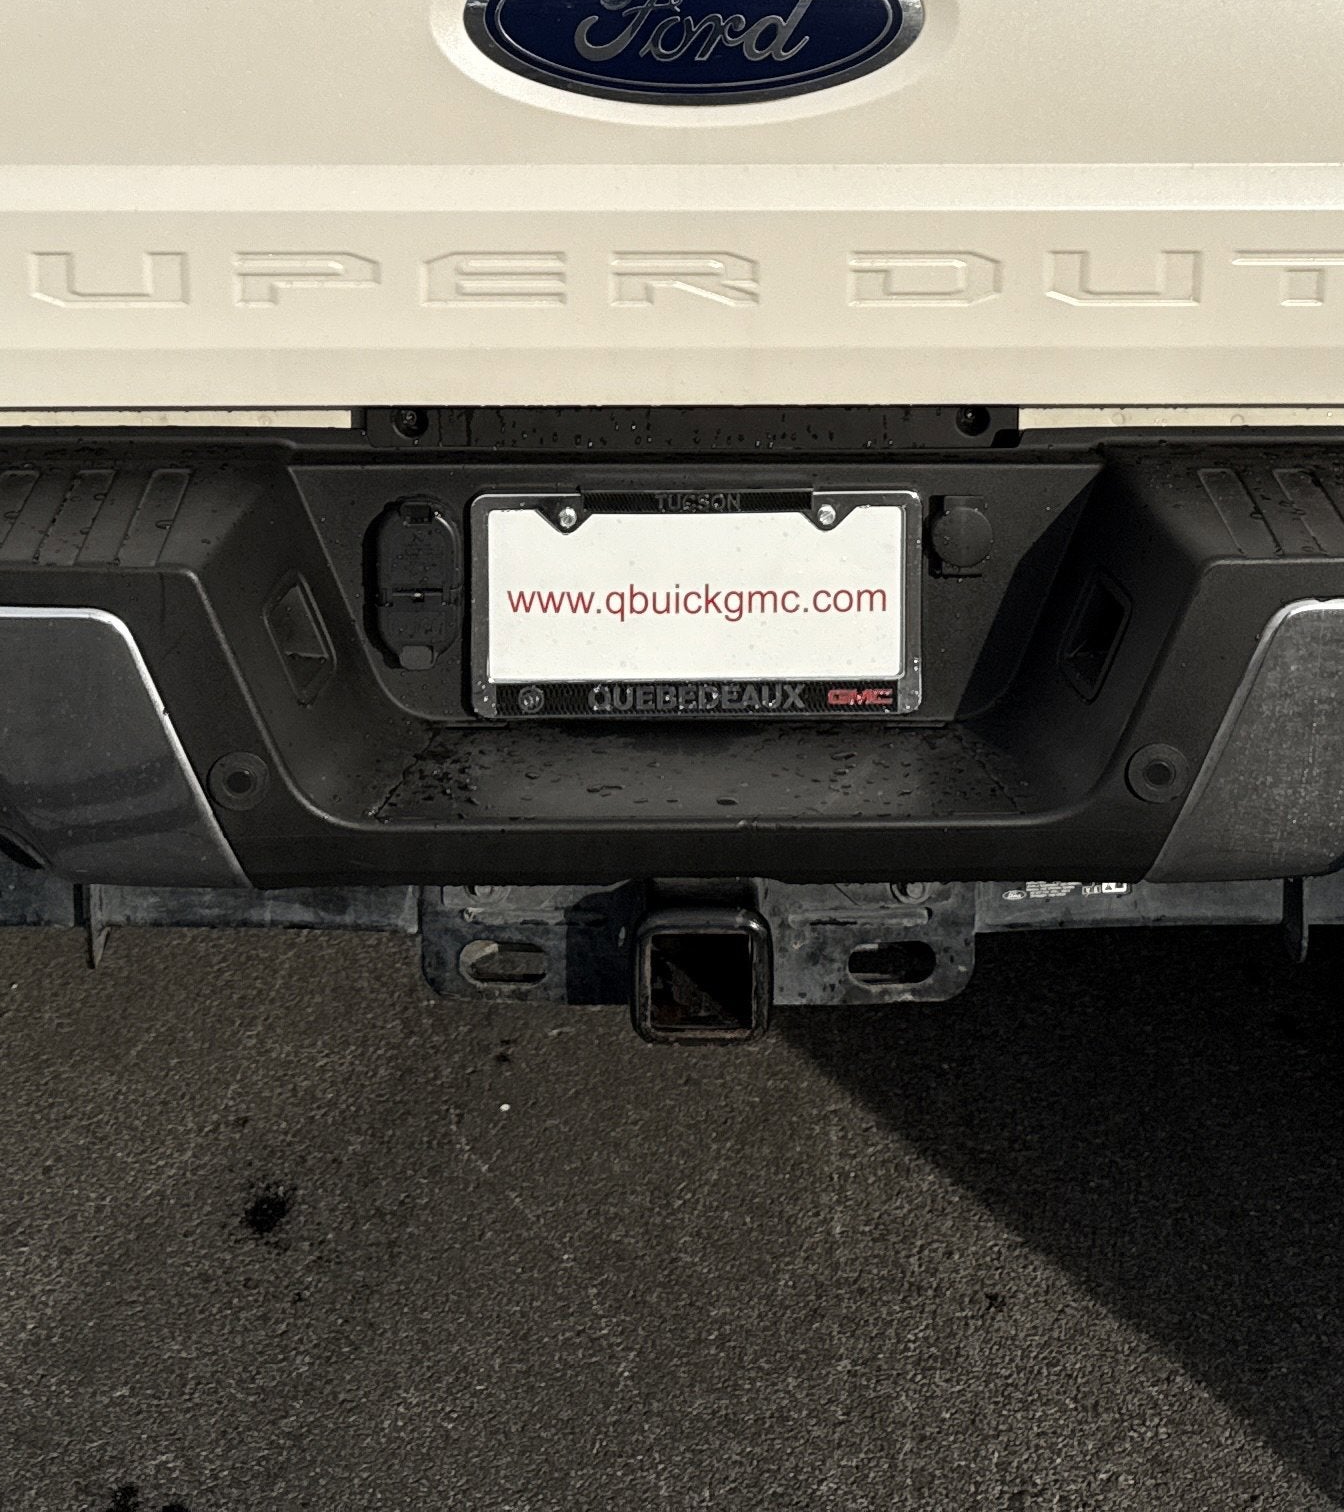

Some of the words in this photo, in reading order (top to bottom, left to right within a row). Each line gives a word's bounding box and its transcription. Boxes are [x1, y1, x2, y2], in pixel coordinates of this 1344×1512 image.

[655, 493, 741, 511] TUCSON
[507, 583, 887, 622] www.qbuickgmc.com
[588, 684, 807, 712] QUEBEDEAUX
[827, 688, 893, 706] GMC
